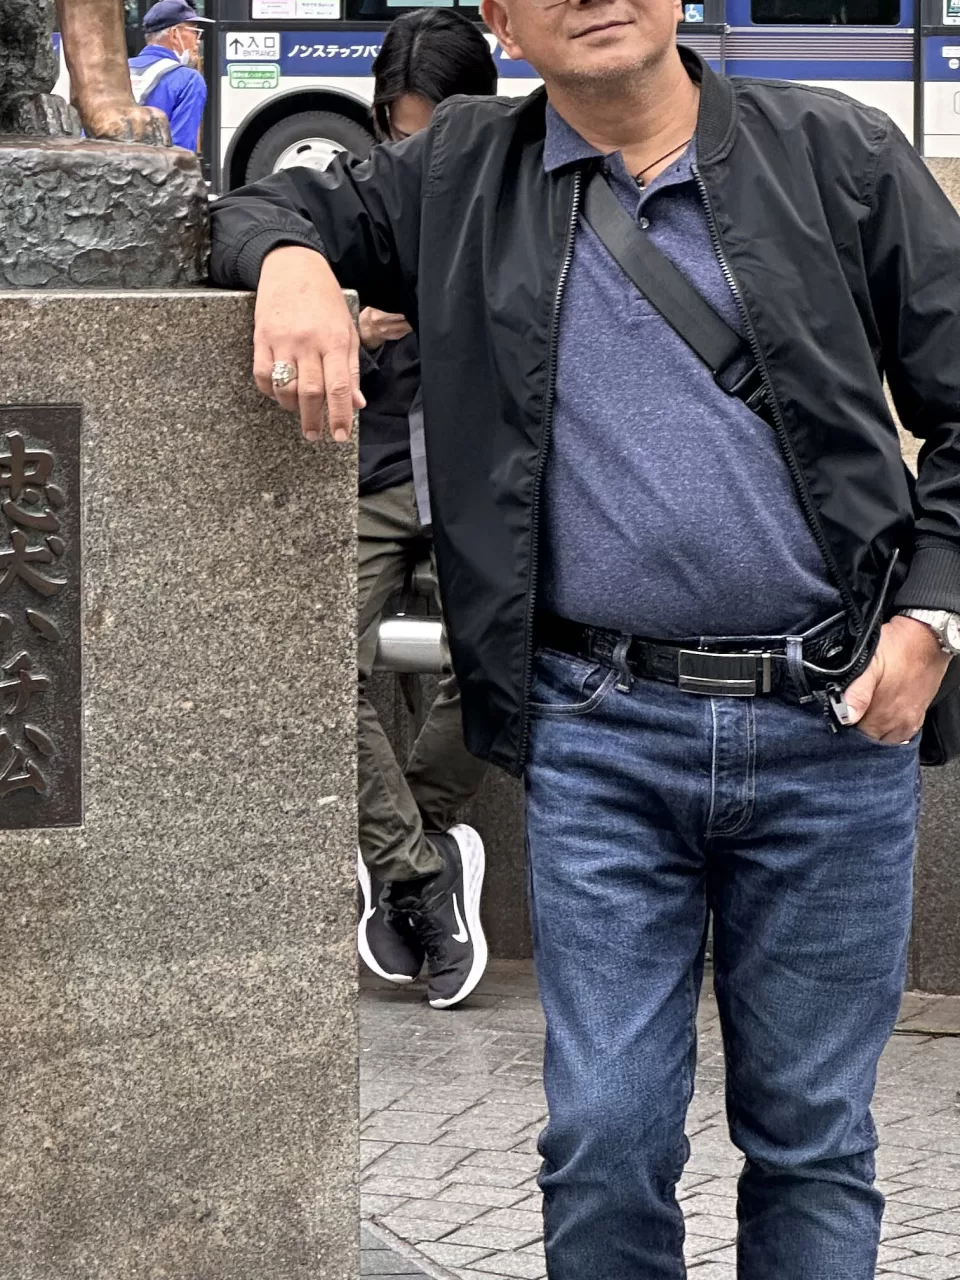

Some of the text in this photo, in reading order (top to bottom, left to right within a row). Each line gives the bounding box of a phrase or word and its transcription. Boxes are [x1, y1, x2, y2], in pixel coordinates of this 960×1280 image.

[247, 36, 276, 49] 入口
[243, 50, 277, 58] ENTRANCE
[287, 44, 382, 58] ノンステップバ
